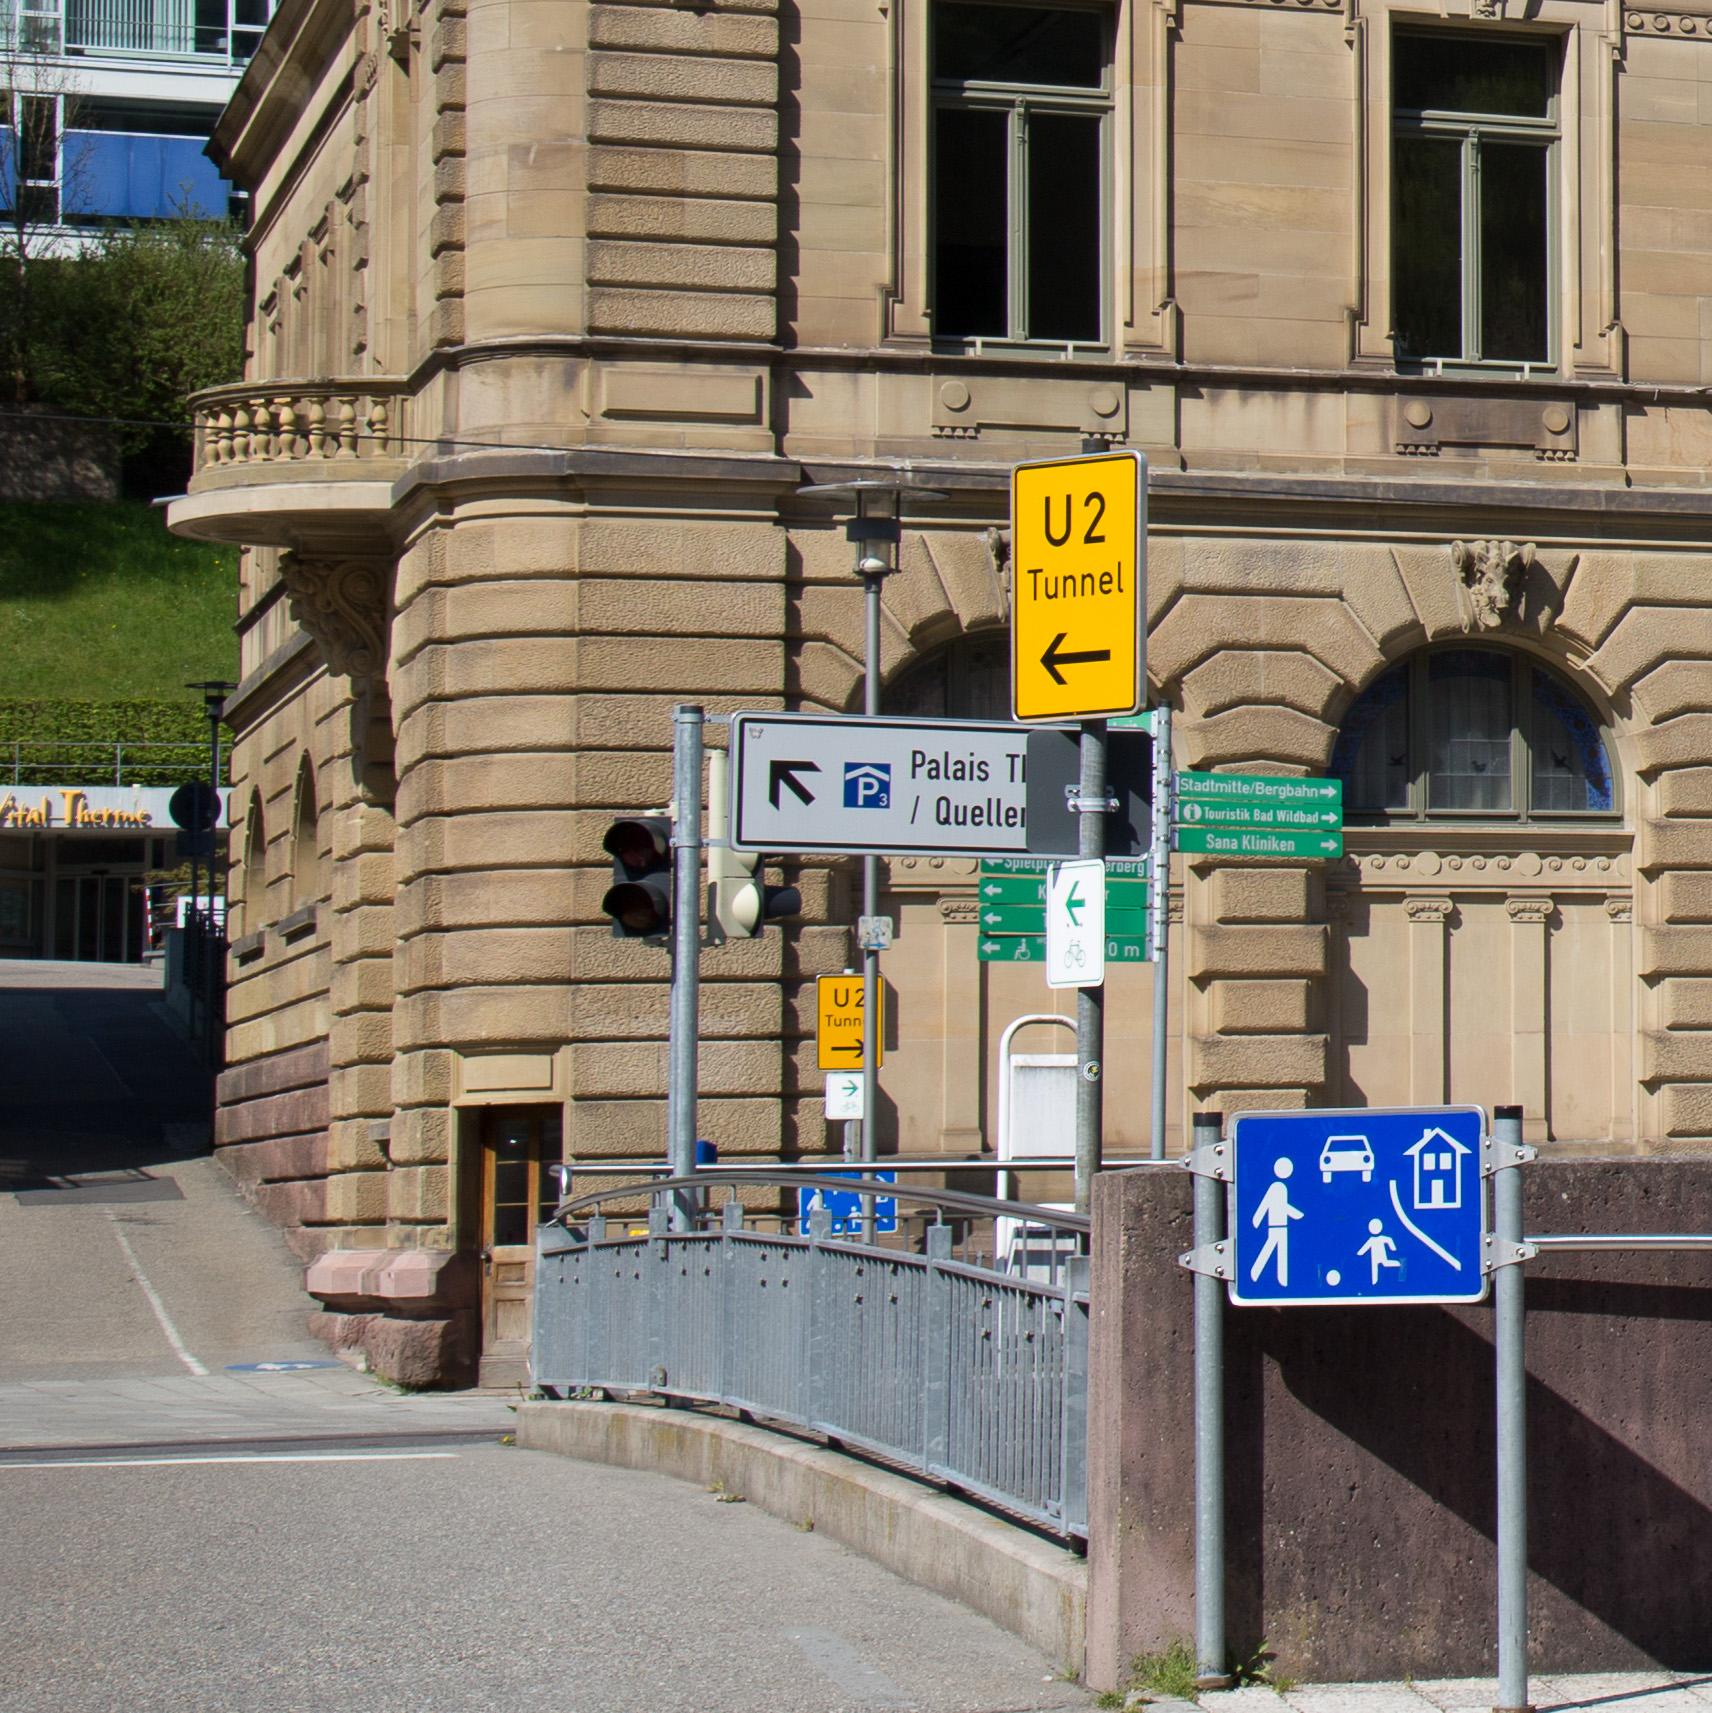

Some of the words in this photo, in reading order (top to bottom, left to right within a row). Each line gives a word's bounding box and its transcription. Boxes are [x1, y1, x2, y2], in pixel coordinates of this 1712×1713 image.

[1027, 561, 1125, 601] Tunnel
[911, 749, 990, 782] Palais
[1179, 778, 1319, 800] Stadtmitte/Bergbahn
[1203, 807, 1250, 822] Touristik
[1254, 809, 1274, 823] Bad
[1277, 810, 1320, 824] Wildbad
[1206, 833, 1238, 851] Sana
[1242, 834, 1296, 852] Kliniken
[825, 1014, 865, 1028] Tunn
